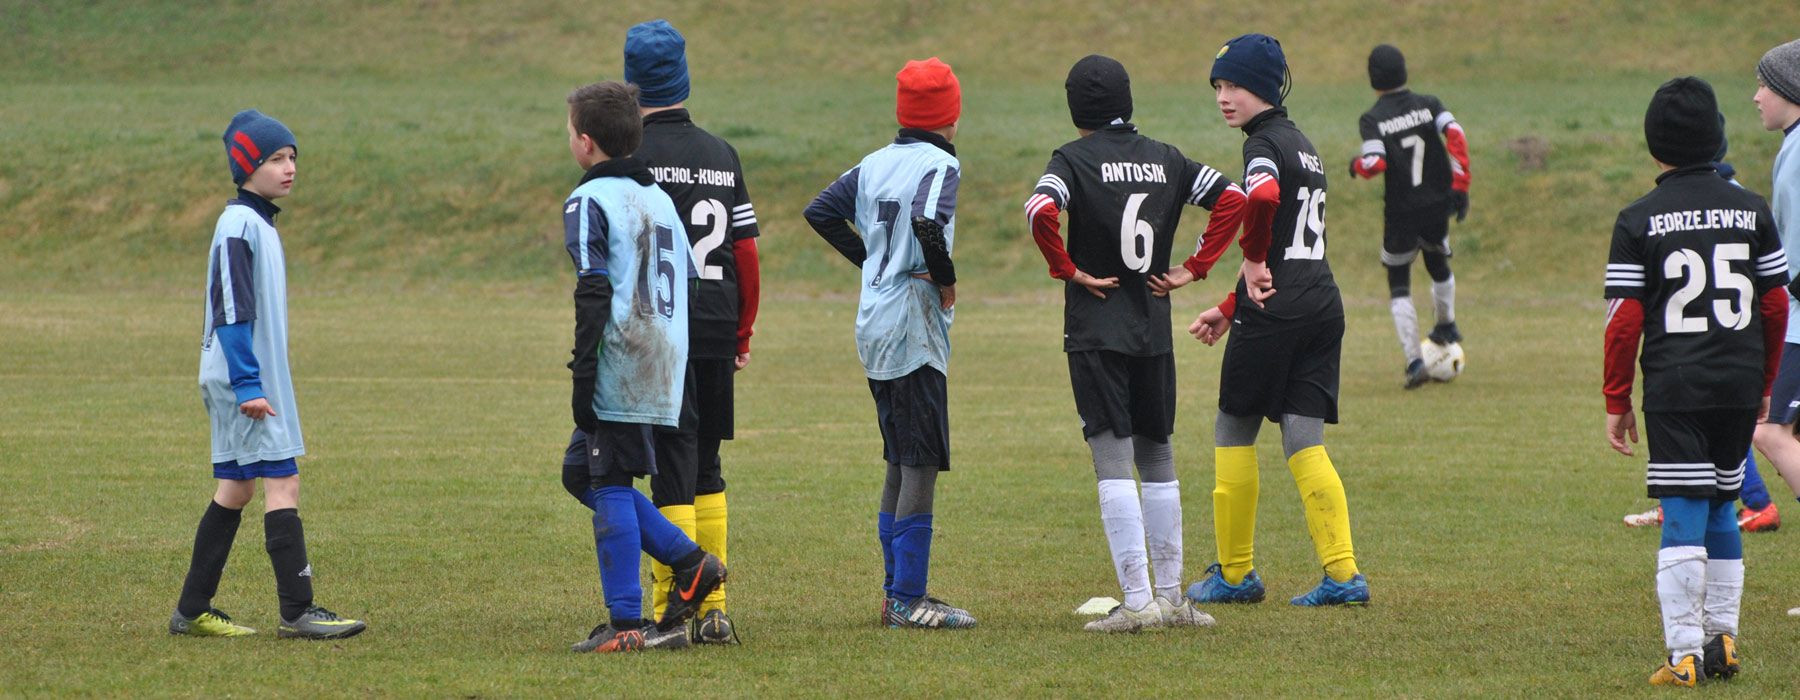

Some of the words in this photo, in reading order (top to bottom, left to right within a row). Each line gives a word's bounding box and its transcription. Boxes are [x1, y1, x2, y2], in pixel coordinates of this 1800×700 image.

[648, 166, 735, 187] UCHOL-KUBIK
[1101, 162, 1166, 183] ANTOSIK
[1401, 135, 1425, 187] 7
[869, 197, 902, 289] 7
[1120, 193, 1154, 273] 6
[1648, 209, 1757, 236] JĘDRZEJEWSKI
[632, 221, 677, 321] 15
[1664, 243, 1754, 333] 25
